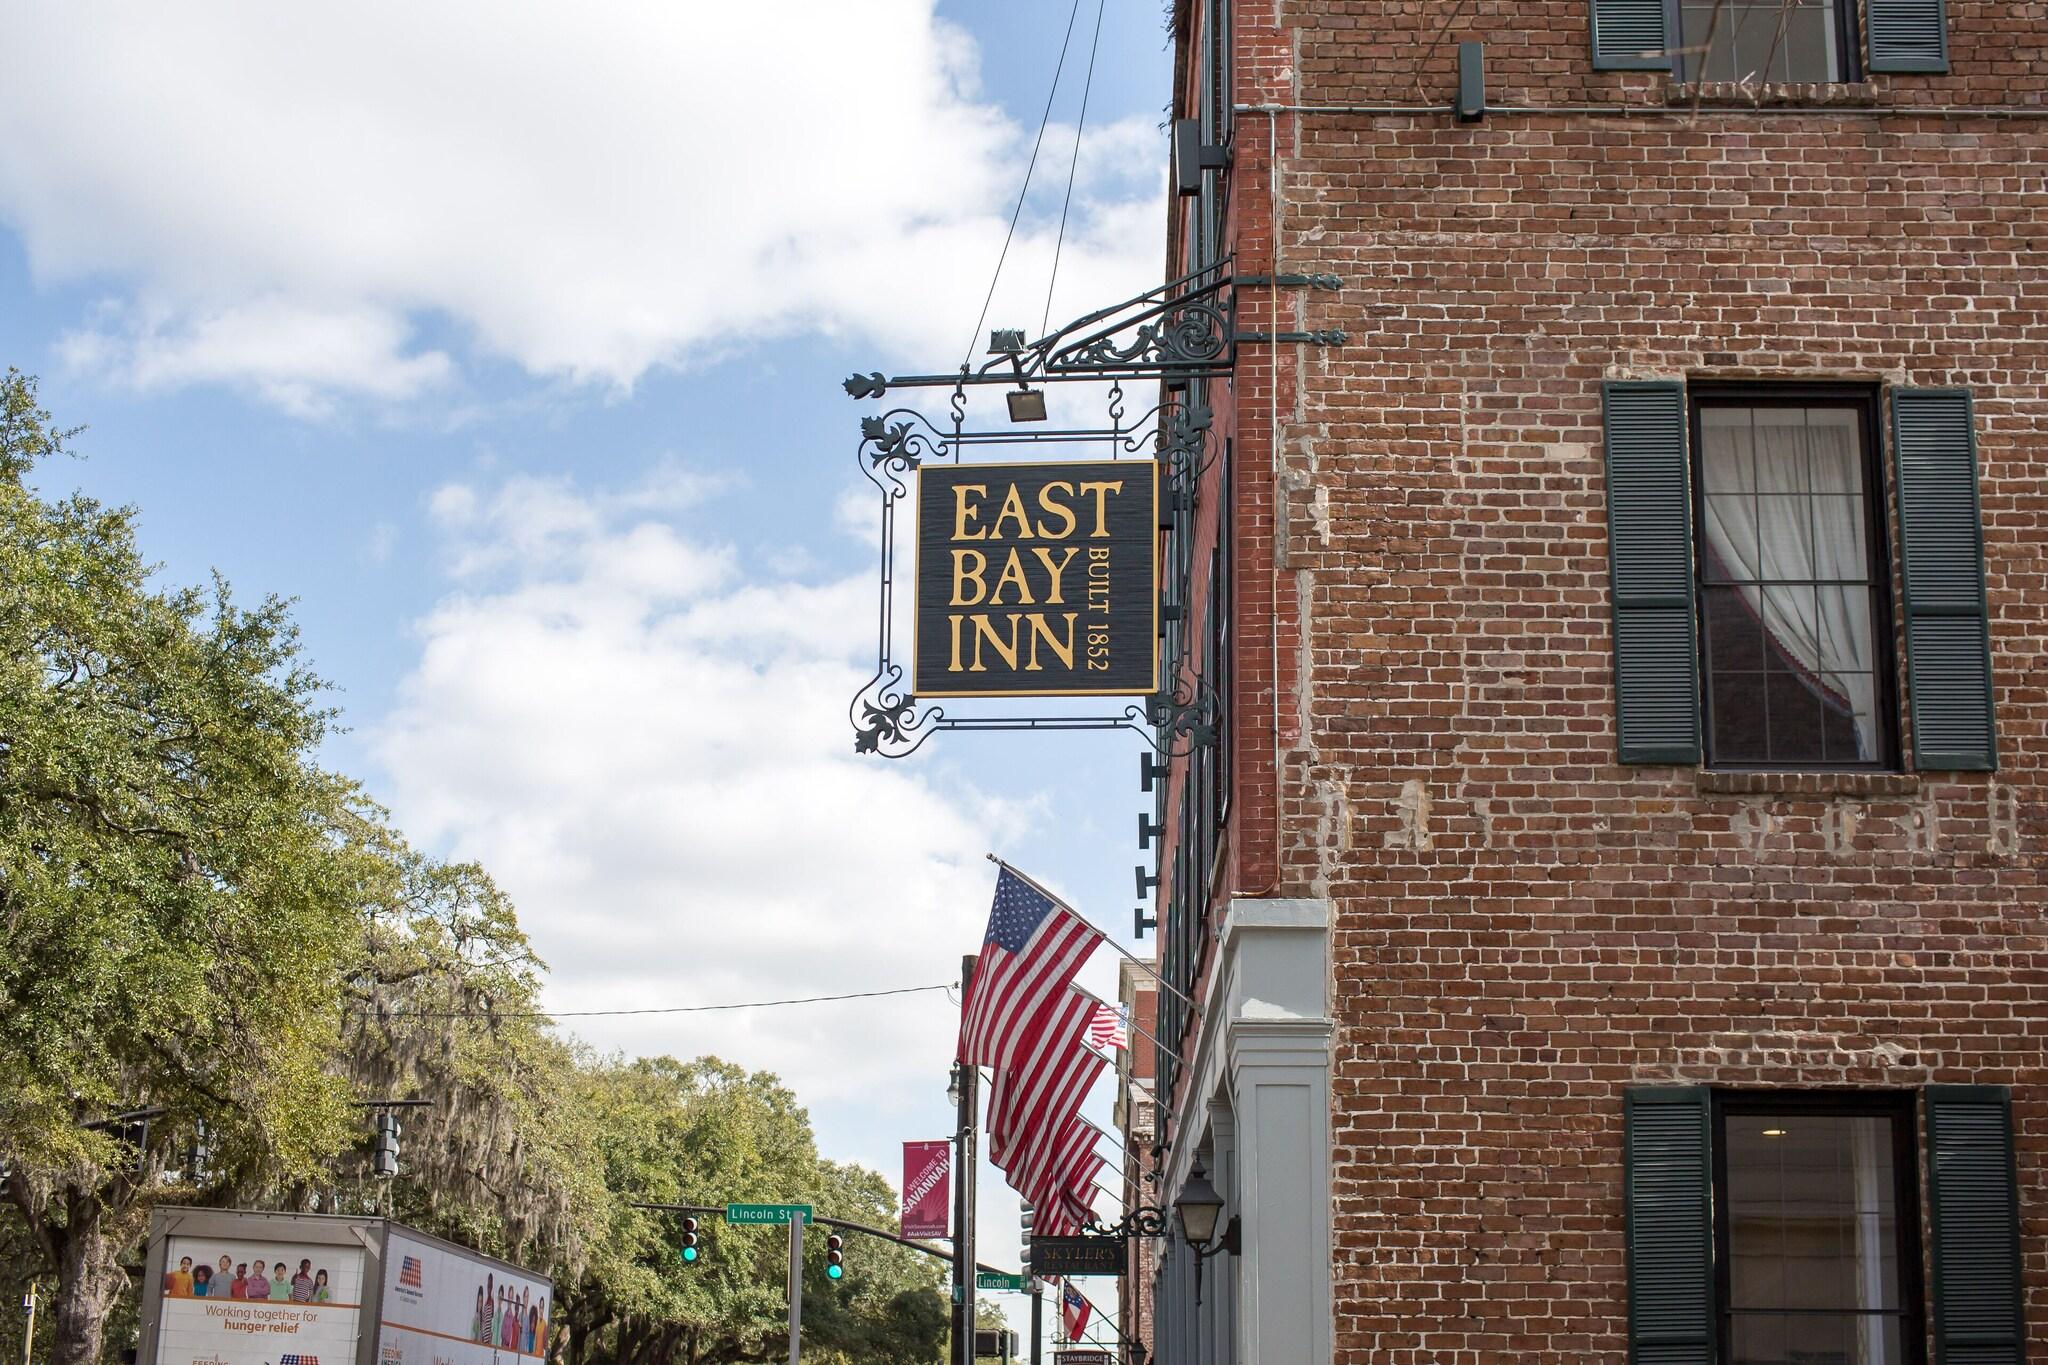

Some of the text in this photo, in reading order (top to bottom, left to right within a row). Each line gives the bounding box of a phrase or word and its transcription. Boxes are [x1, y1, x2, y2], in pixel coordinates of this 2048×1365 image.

[950, 480, 1124, 541] EAST
[948, 546, 1080, 606] BAY
[1087, 546, 1110, 671] BUILT 1852
[947, 612, 1079, 672] INN
[902, 1158, 950, 1214] SAVANNAH
[907, 1149, 946, 1192] WELCOME TO
[732, 1208, 791, 1220] Lincoln St
[1043, 1247, 1116, 1260] SKYLER'S
[978, 1276, 1010, 1288] Lincoln
[205, 1305, 318, 1322] Working together for
[224, 1319, 300, 1334] hunger relief
